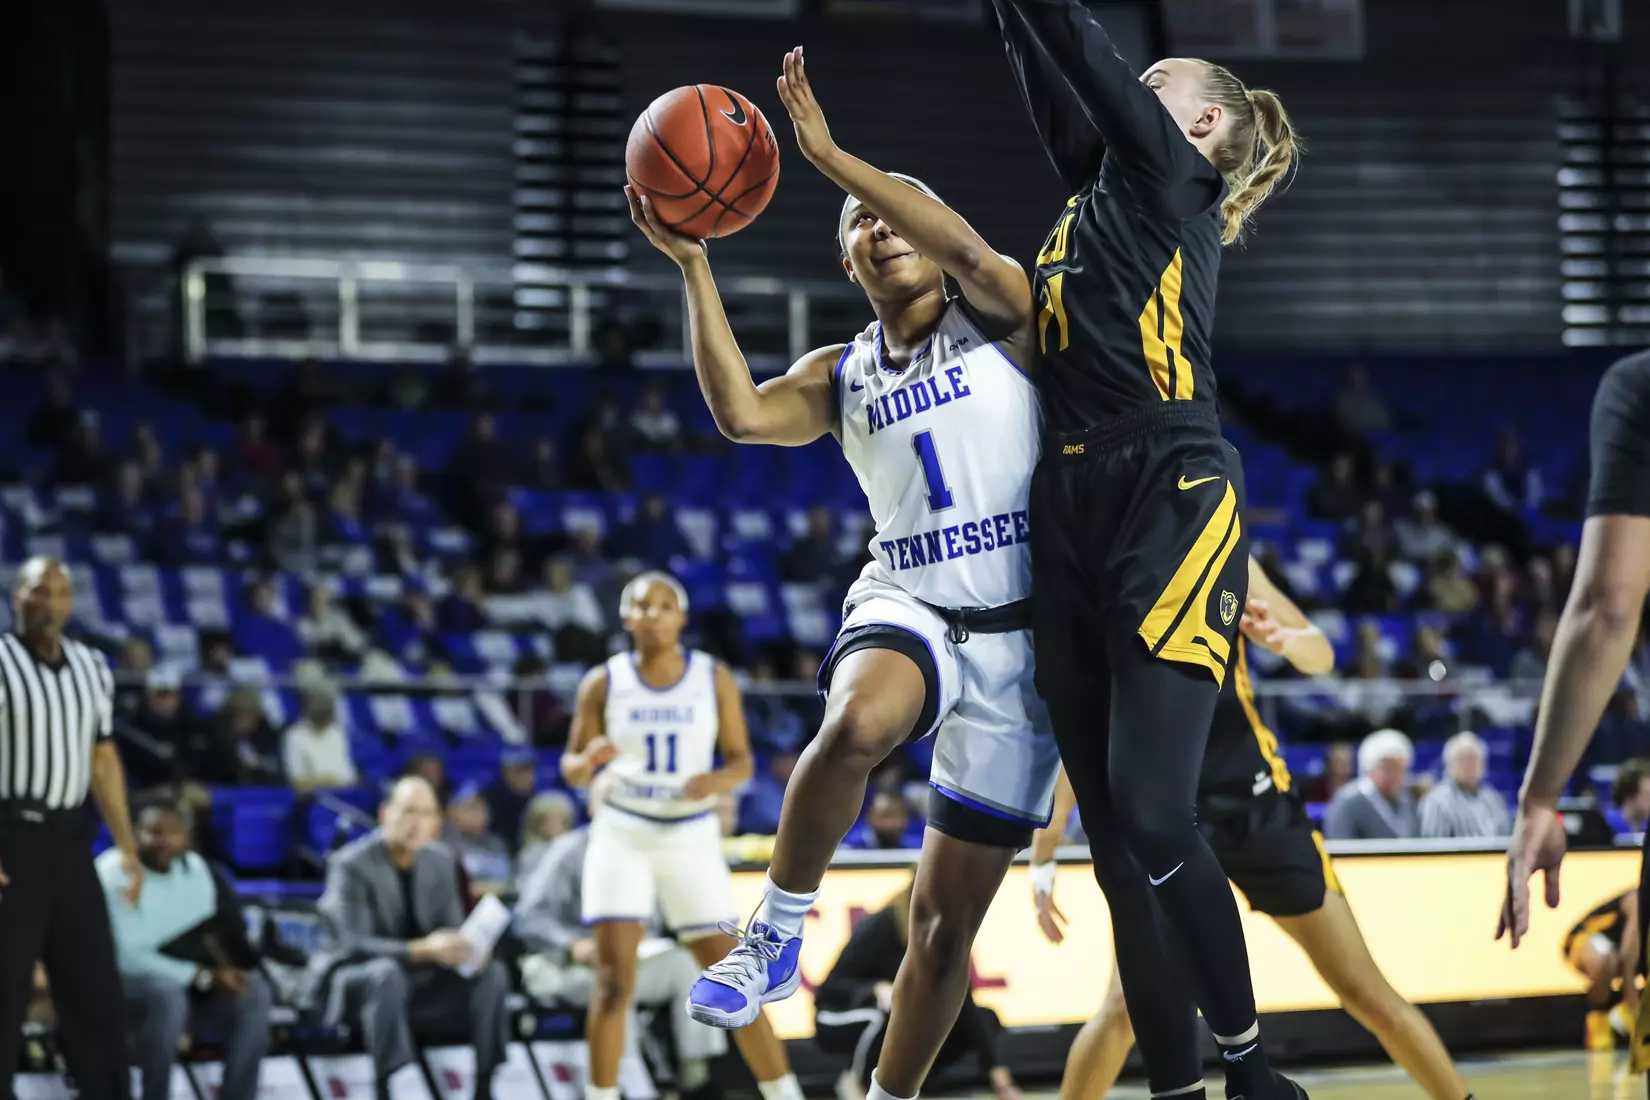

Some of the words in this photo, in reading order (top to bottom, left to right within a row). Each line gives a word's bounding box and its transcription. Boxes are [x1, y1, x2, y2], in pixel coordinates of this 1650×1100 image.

[866, 365, 971, 435] MIDDLE
[910, 427, 956, 514] 1
[879, 509, 1028, 571] TENNESSEE
[644, 731, 678, 774] 11
